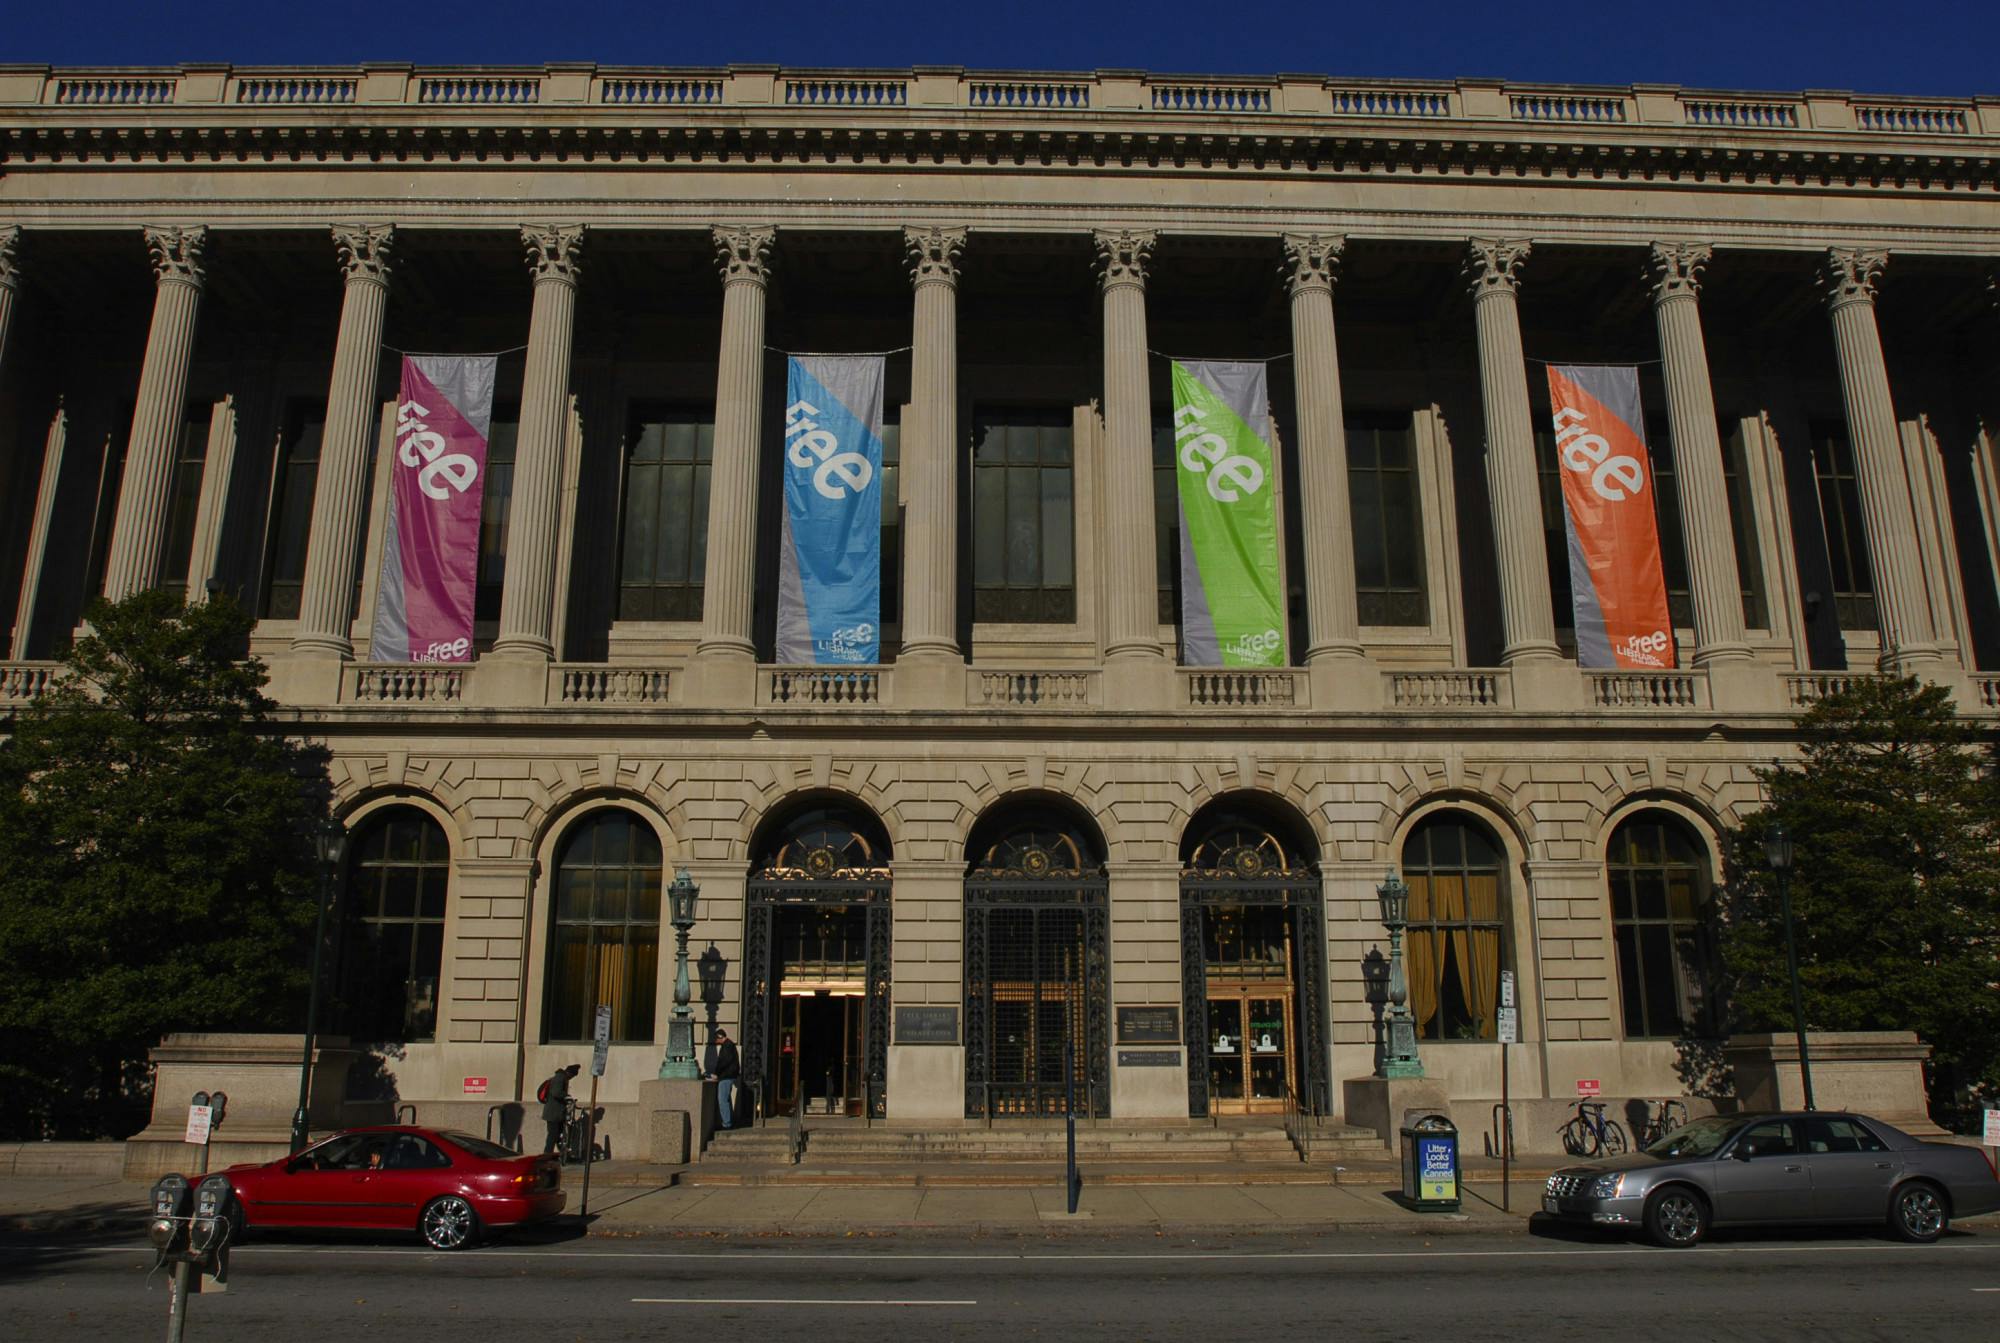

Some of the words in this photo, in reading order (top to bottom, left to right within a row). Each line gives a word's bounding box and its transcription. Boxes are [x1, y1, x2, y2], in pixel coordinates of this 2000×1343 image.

[396, 400, 478, 500] Free
[786, 400, 872, 499] Free
[1174, 404, 1264, 502] Free
[1553, 407, 1643, 501] Free
[832, 623, 872, 647] Free
[1240, 629, 1280, 651] Free
[1628, 630, 1667, 653] Free
[428, 638, 469, 659] Free
[1616, 644, 1657, 660] LIBRARY
[1425, 1152, 1449, 1161] Looks
[1427, 1144, 1447, 1153] Litter
[1424, 1168, 1453, 1177] Canned
[1426, 1161, 1449, 1169] Better
